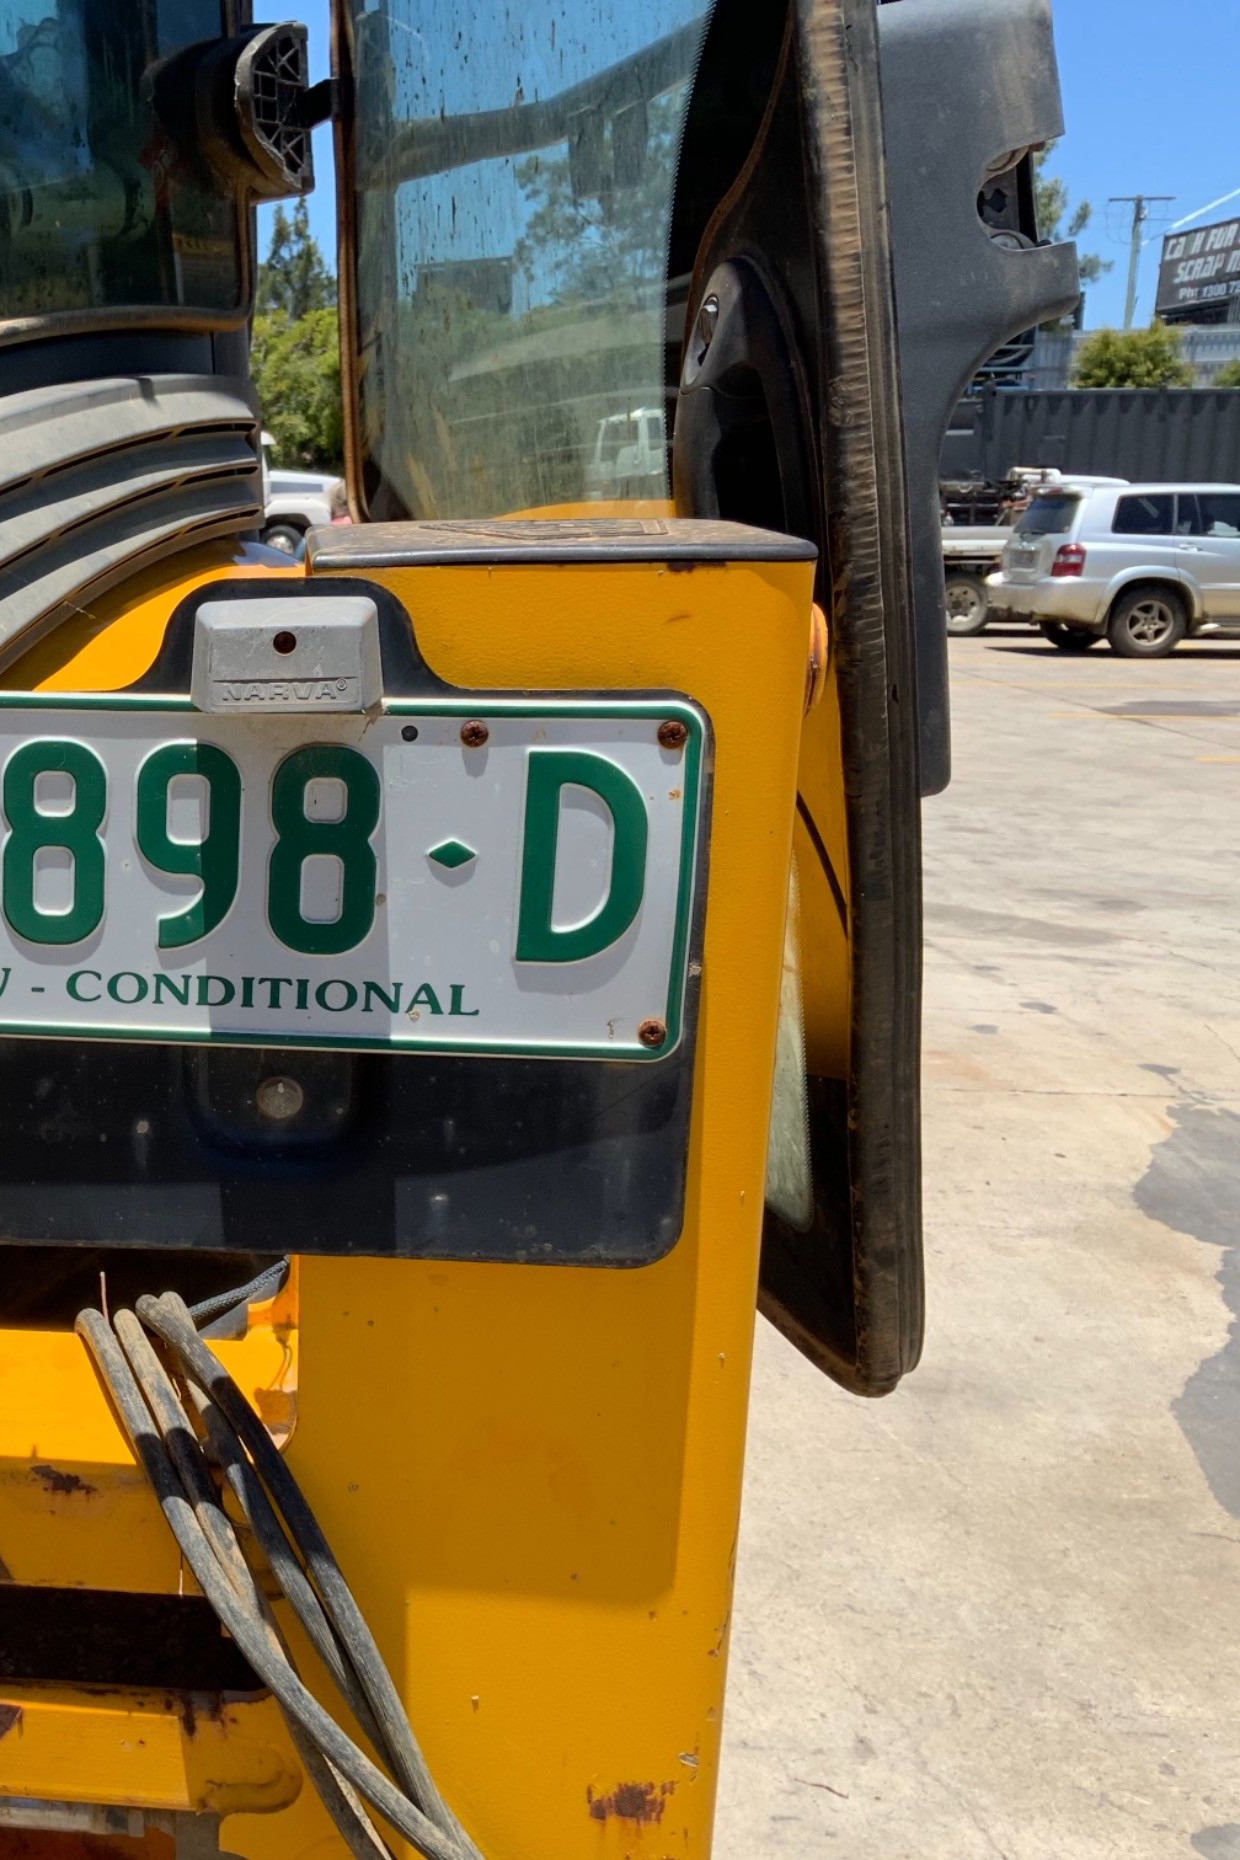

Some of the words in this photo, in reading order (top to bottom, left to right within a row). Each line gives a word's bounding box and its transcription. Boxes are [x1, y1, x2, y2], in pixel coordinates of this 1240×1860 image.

[1164, 231, 1206, 260] CAH
[1174, 254, 1226, 283] SCRAP
[66, 969, 480, 1017] CONDITIONAL
